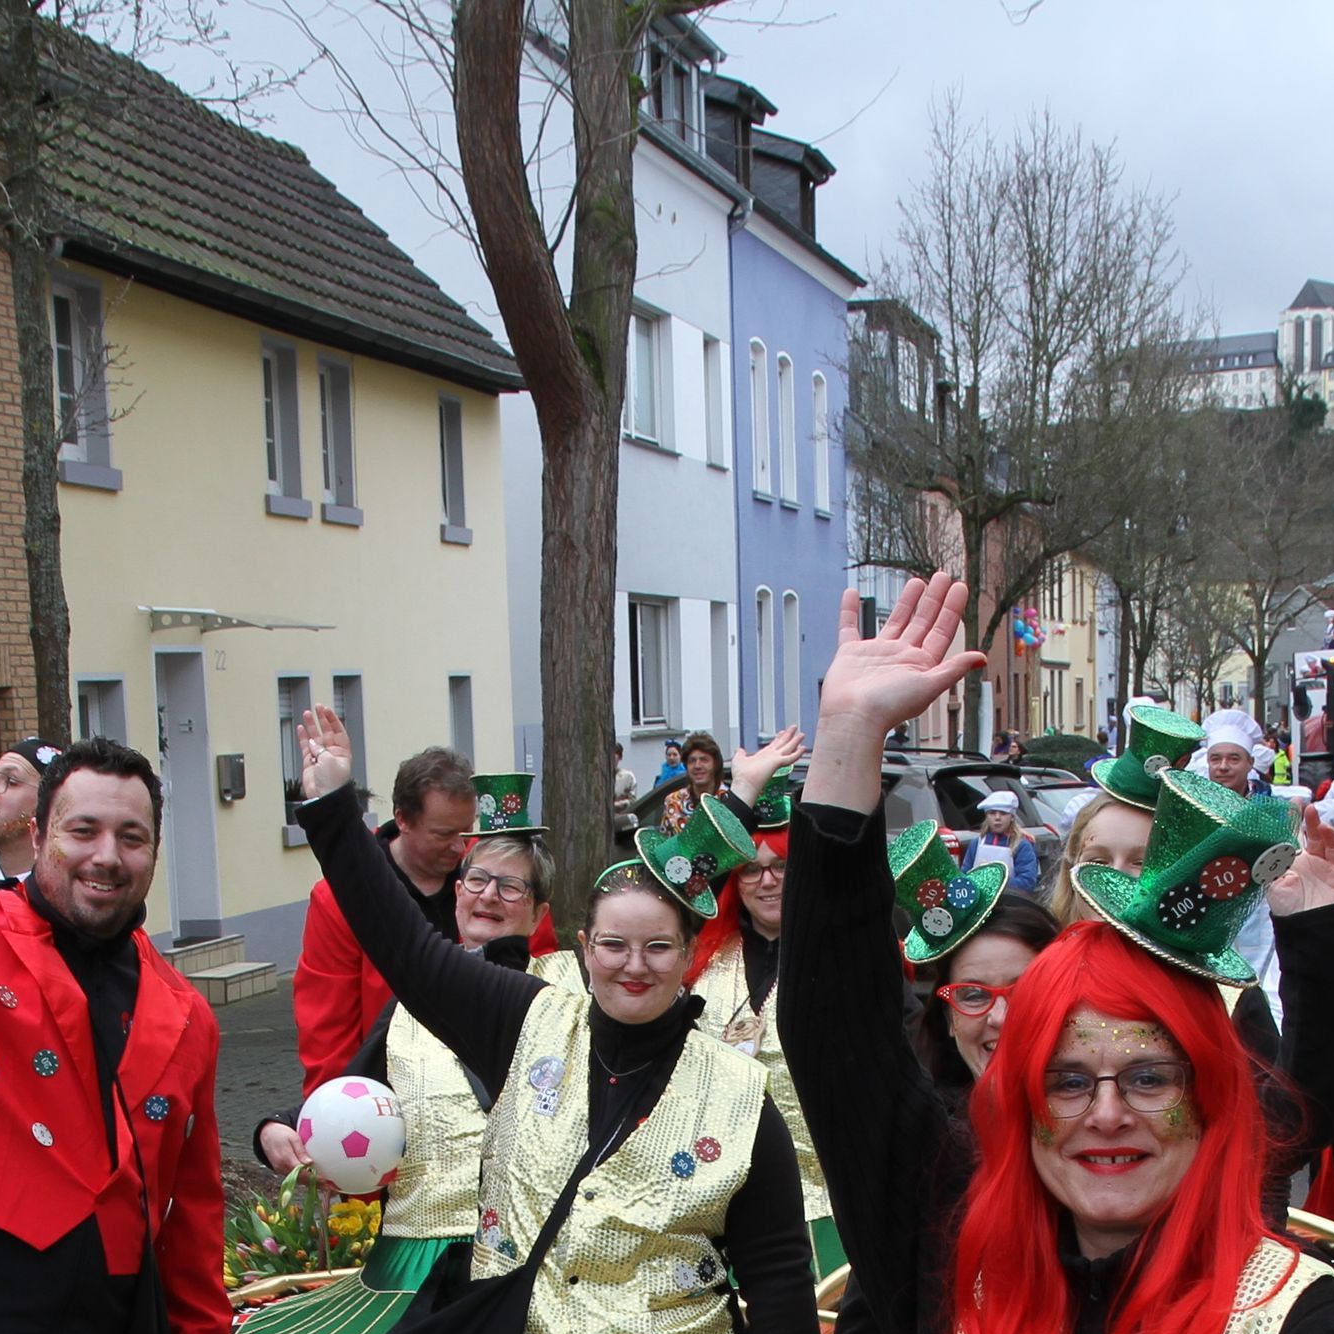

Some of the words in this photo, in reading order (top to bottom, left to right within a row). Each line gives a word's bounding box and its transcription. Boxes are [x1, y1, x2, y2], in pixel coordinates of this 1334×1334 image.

[675, 866, 683, 875] 5
[1269, 859, 1281, 871] 5
[1213, 871, 1235, 887] 10
[925, 889, 938, 901] 10
[955, 888, 968, 899] 50
[1170, 897, 1194, 919] 100
[933, 918, 943, 926] 5
[151, 1104, 162, 1114] 50
[703, 1143, 714, 1154] 10
[677, 1159, 688, 1170] 50
[683, 1272, 688, 1281] 5
